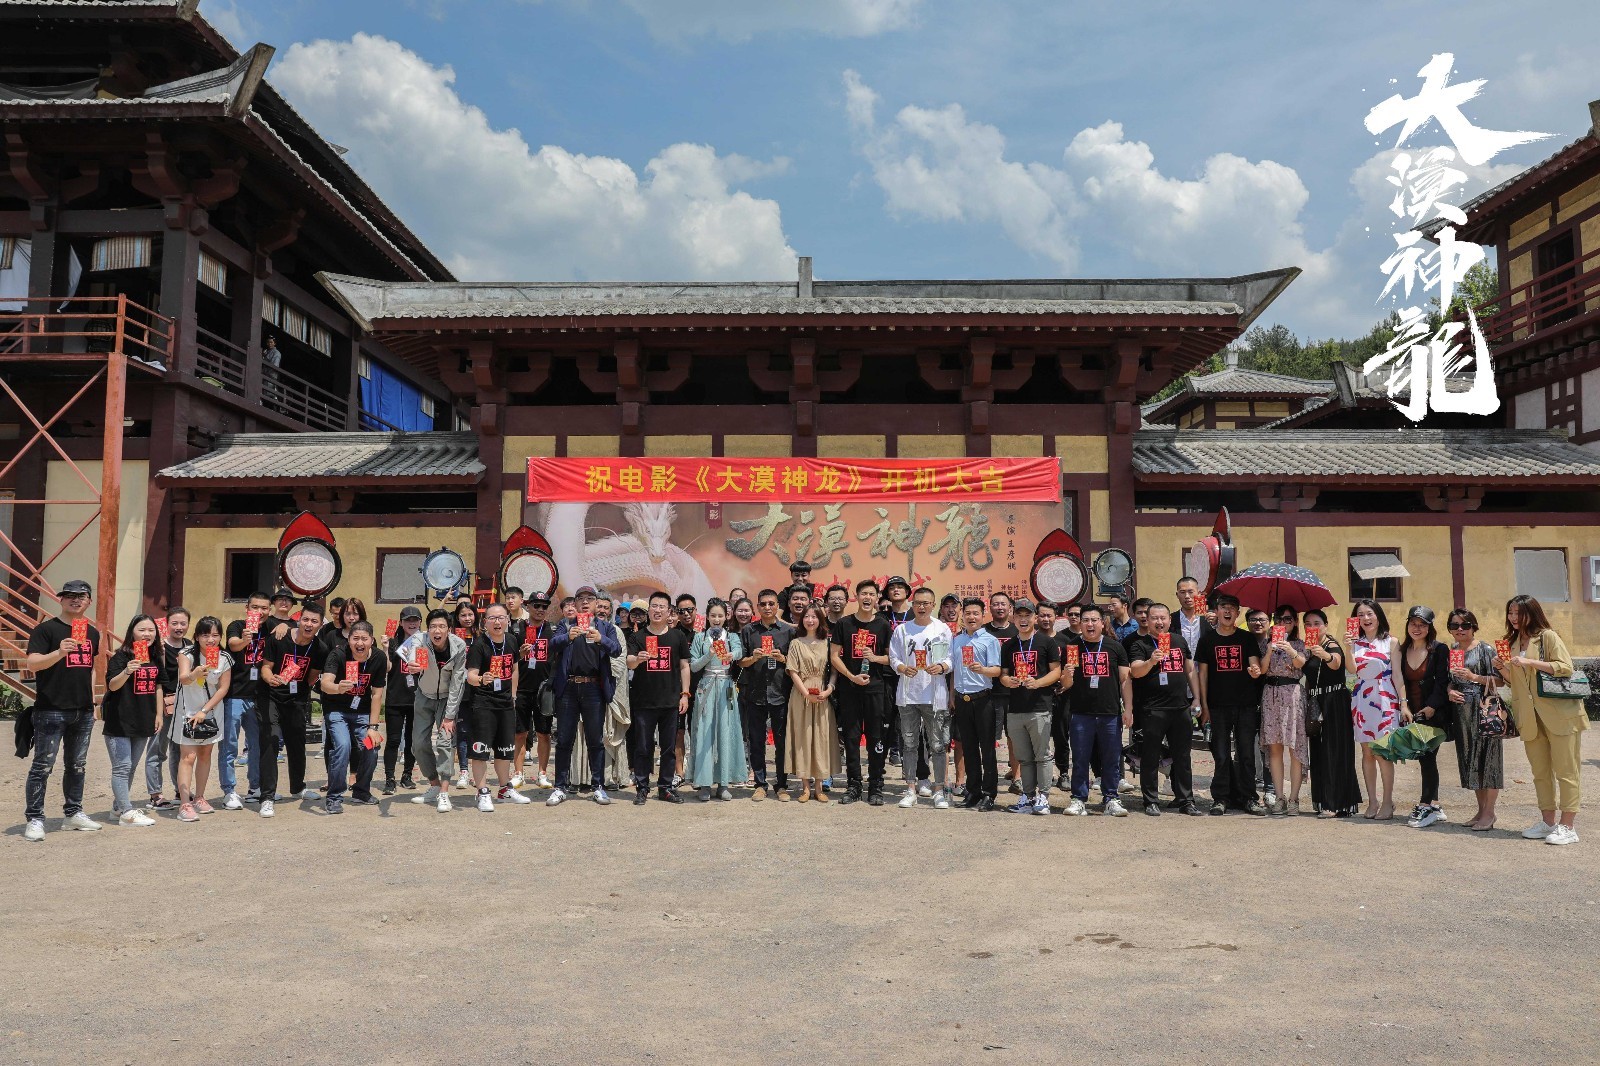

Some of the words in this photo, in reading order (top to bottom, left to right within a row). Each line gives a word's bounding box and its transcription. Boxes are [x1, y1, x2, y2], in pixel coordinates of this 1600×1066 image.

[585, 465, 1006, 493] 祝电影《大漠神龙》开机大吉
